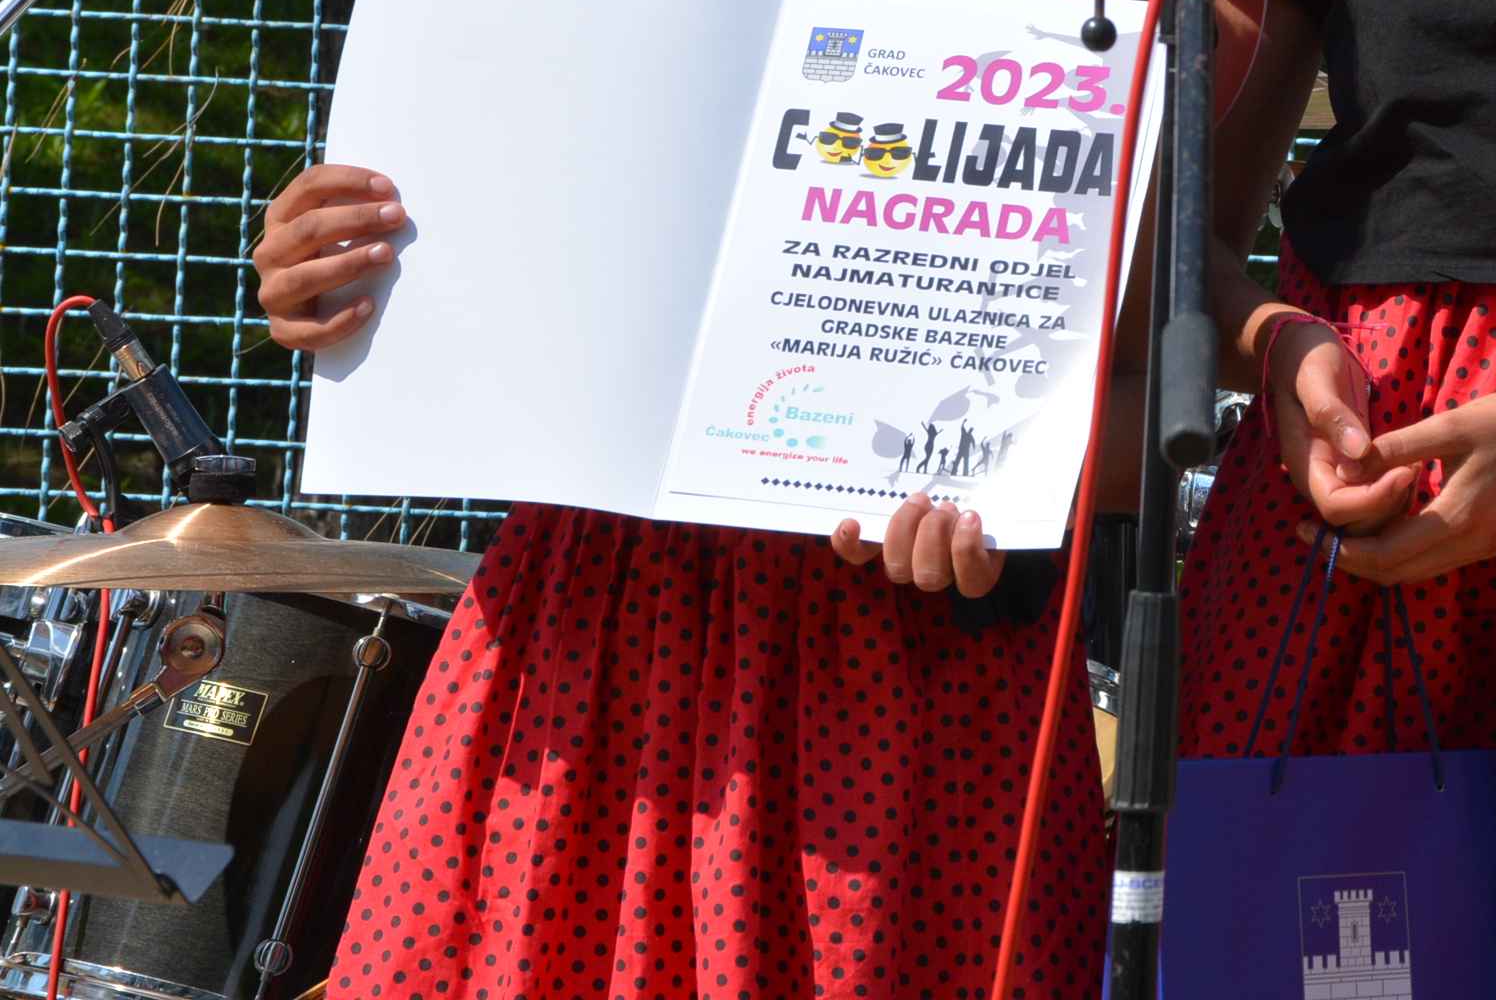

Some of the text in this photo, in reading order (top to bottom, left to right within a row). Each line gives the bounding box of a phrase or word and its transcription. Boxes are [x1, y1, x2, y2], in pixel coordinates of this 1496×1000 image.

[868, 48, 906, 60] GRAD
[863, 62, 926, 79] ČAKOVEC
[936, 55, 1125, 115] 2023.
[801, 186, 1070, 244] NAGRADA
[782, 240, 1076, 279] ZA RAZREDNI ODJEL
[791, 263, 1060, 301] NAJMATURANTICE
[770, 291, 1066, 330] CJELODNEVNA ULAZNICA ZA
[821, 319, 1008, 349] GRADSKE BAZENE
[950, 352, 1047, 375] ČAKOVEC
[747, 364, 815, 426] energija života
[785, 406, 855, 426] Bazeni
[705, 425, 770, 442] Čakovec
[741, 448, 756, 456] we
[806, 454, 829, 464] your
[832, 456, 849, 465] life
[180, 703, 203, 715] MARS
[221, 711, 249, 725] SERIES
